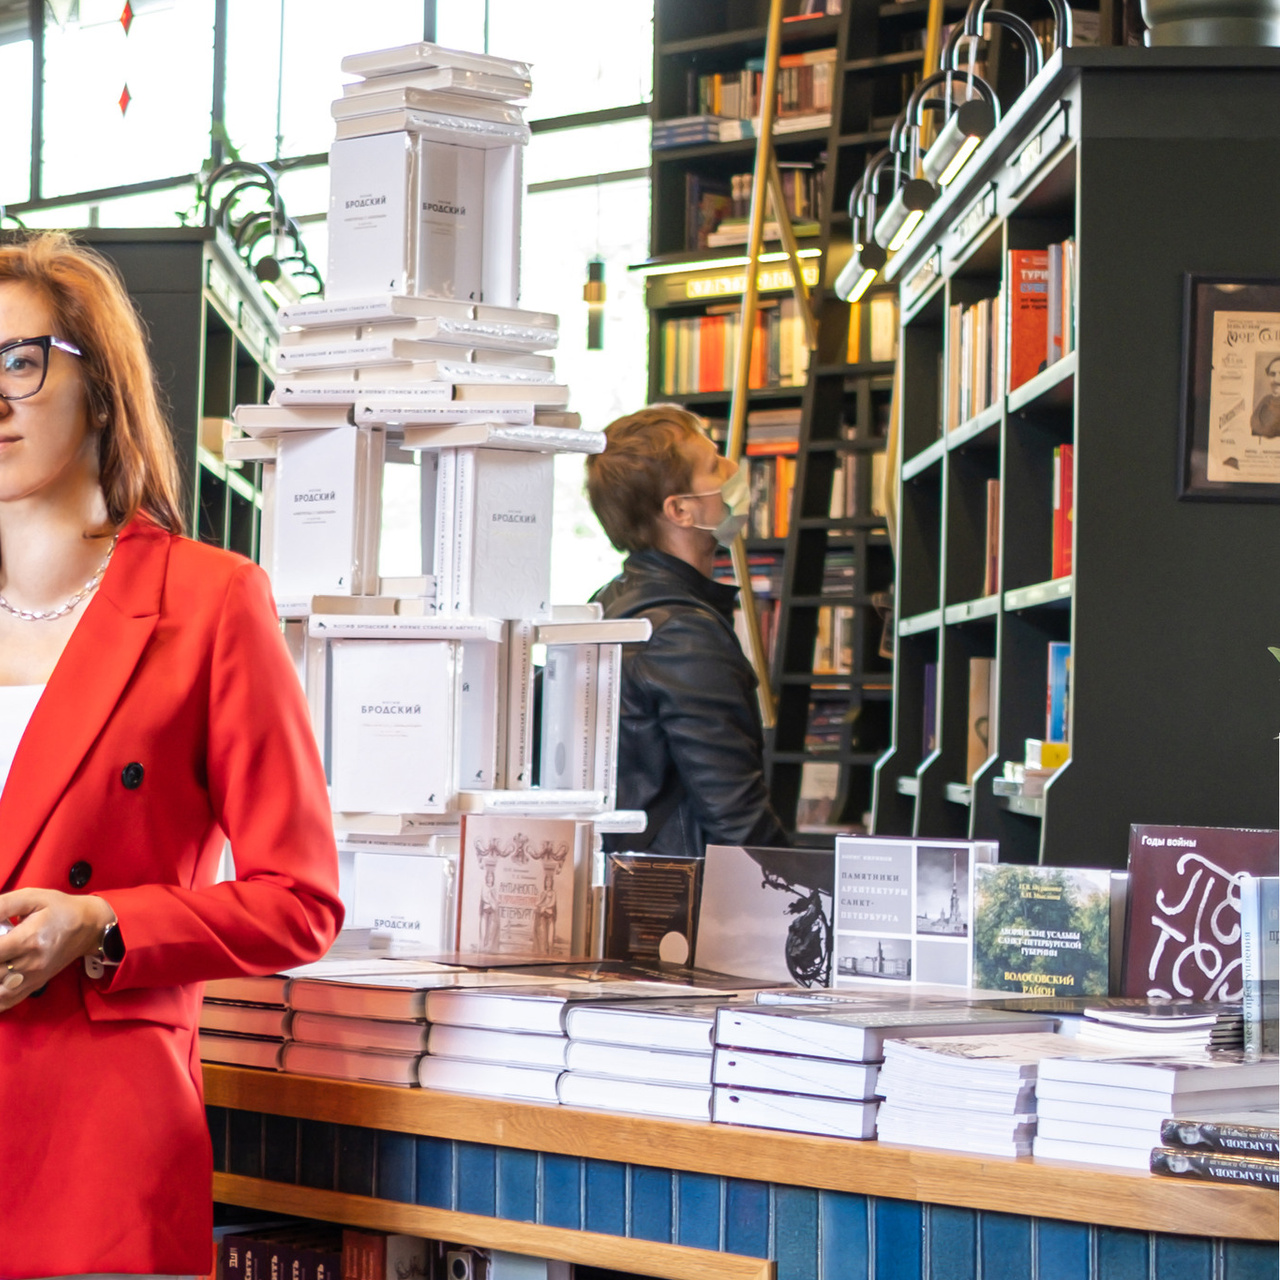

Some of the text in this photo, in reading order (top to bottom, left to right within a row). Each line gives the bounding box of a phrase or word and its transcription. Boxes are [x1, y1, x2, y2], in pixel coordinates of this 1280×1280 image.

[345, 195, 387, 209] БРОДСКИЙ
[422, 202, 466, 216] БРОДСКИЙ
[294, 491, 336, 503] БРОДСКИЙ
[492, 513, 537, 524] БРОДСКИЙ
[361, 704, 422, 715] БРОДСКИЙ
[1141, 835, 1197, 848] Годы войны
[841, 872, 900, 882] ПАМЯТНИКИ
[840, 885, 909, 897] АРХИТЕКТУРЫ
[840, 899, 875, 907] САНКТ-
[840, 911, 899, 923] ПЕТЕРБУРГА
[374, 918, 421, 931] БРОДСКИЙ
[1244, 931, 1254, 1010] преступления
[1004, 971, 1074, 986] ВОЛОСОВСКИЙ
[1022, 984, 1055, 997] РАЙОН
[1219, 1137, 1272, 1152] БАРСКОВА
[1208, 1167, 1262, 1182] БАРСКОВА
